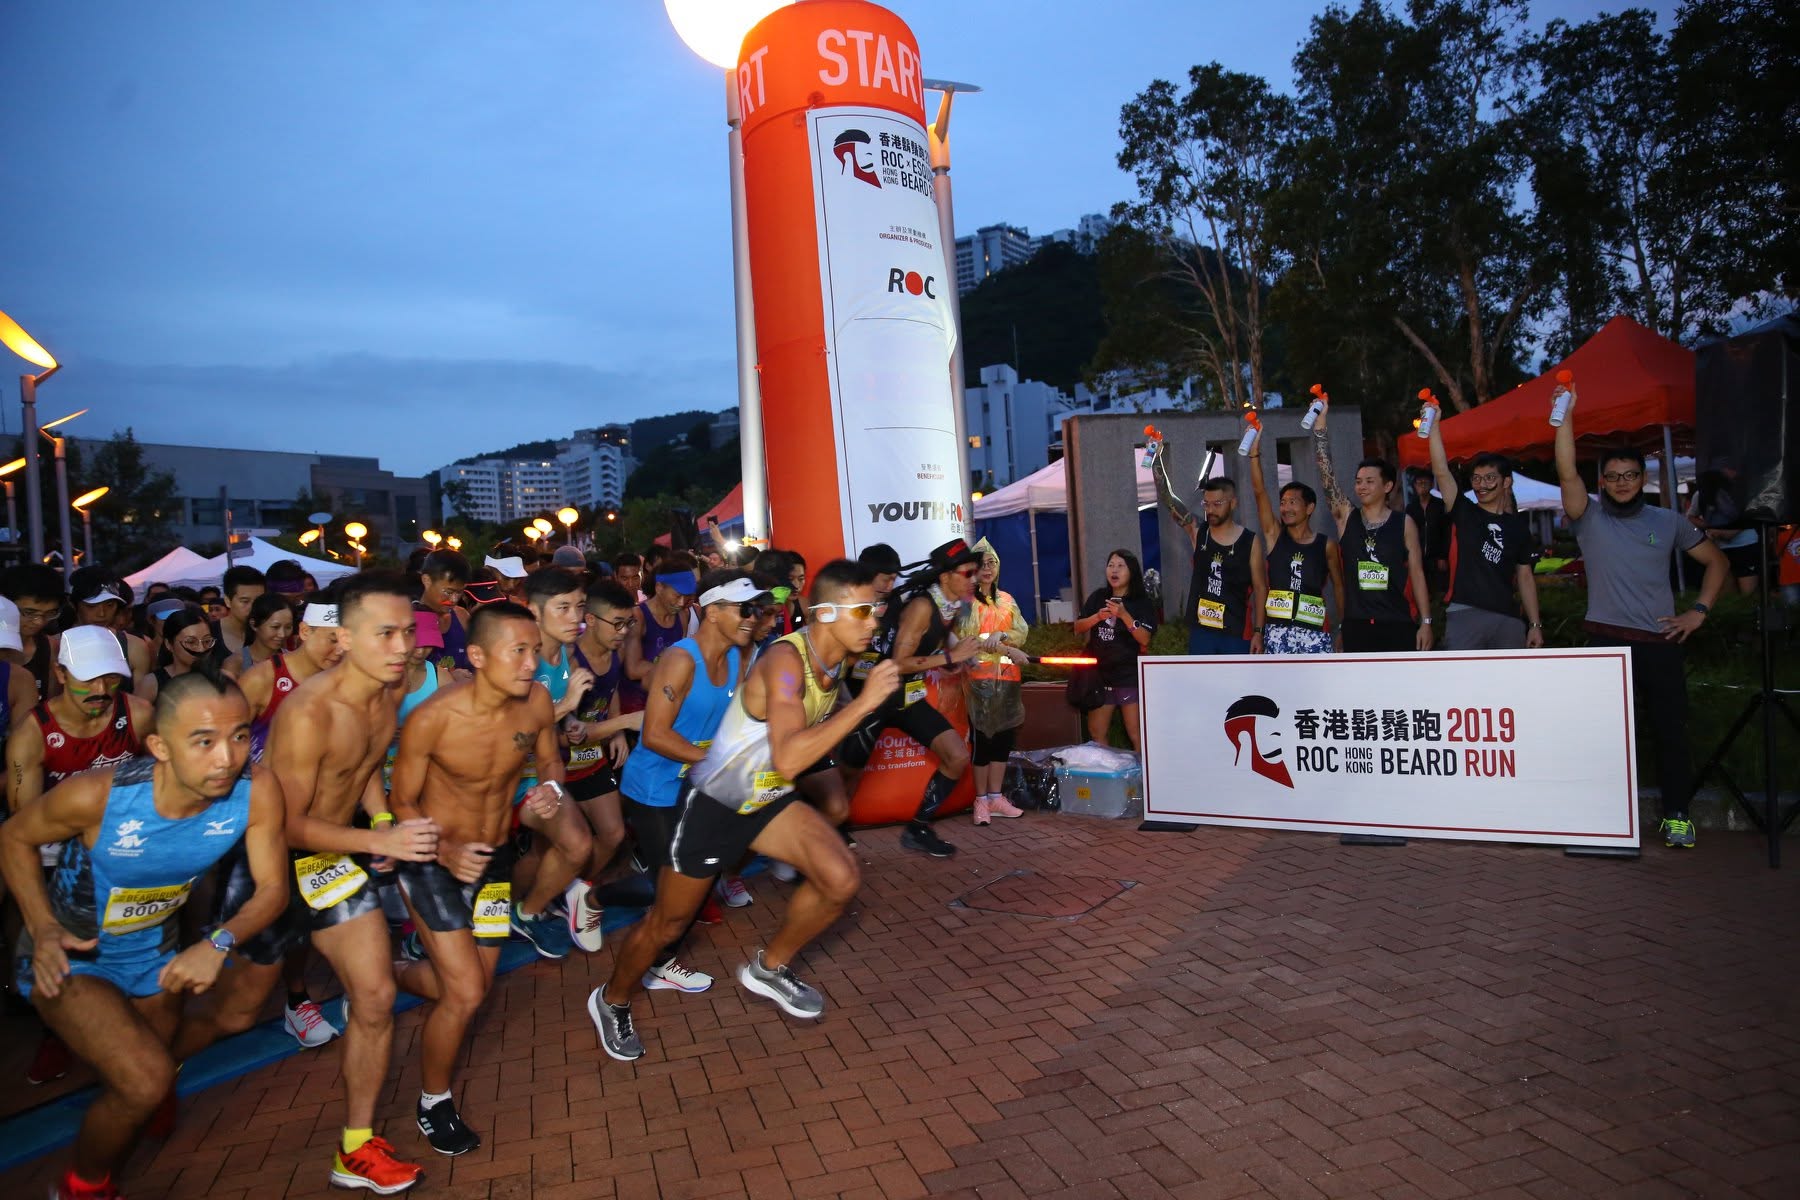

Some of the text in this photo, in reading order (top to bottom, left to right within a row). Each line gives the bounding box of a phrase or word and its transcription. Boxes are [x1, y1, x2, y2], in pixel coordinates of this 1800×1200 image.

[817, 29, 924, 111] START
[739, 45, 769, 126] RT
[881, 149, 904, 169] ROC
[901, 171, 929, 197] BEARD
[1363, 572, 1385, 580] 30302
[888, 760, 926, 769] transform
[1296, 746, 1515, 778] ROC HONG KONG BEARD RUN
[310, 864, 350, 890] 80347
[483, 904, 511, 916] 8014
